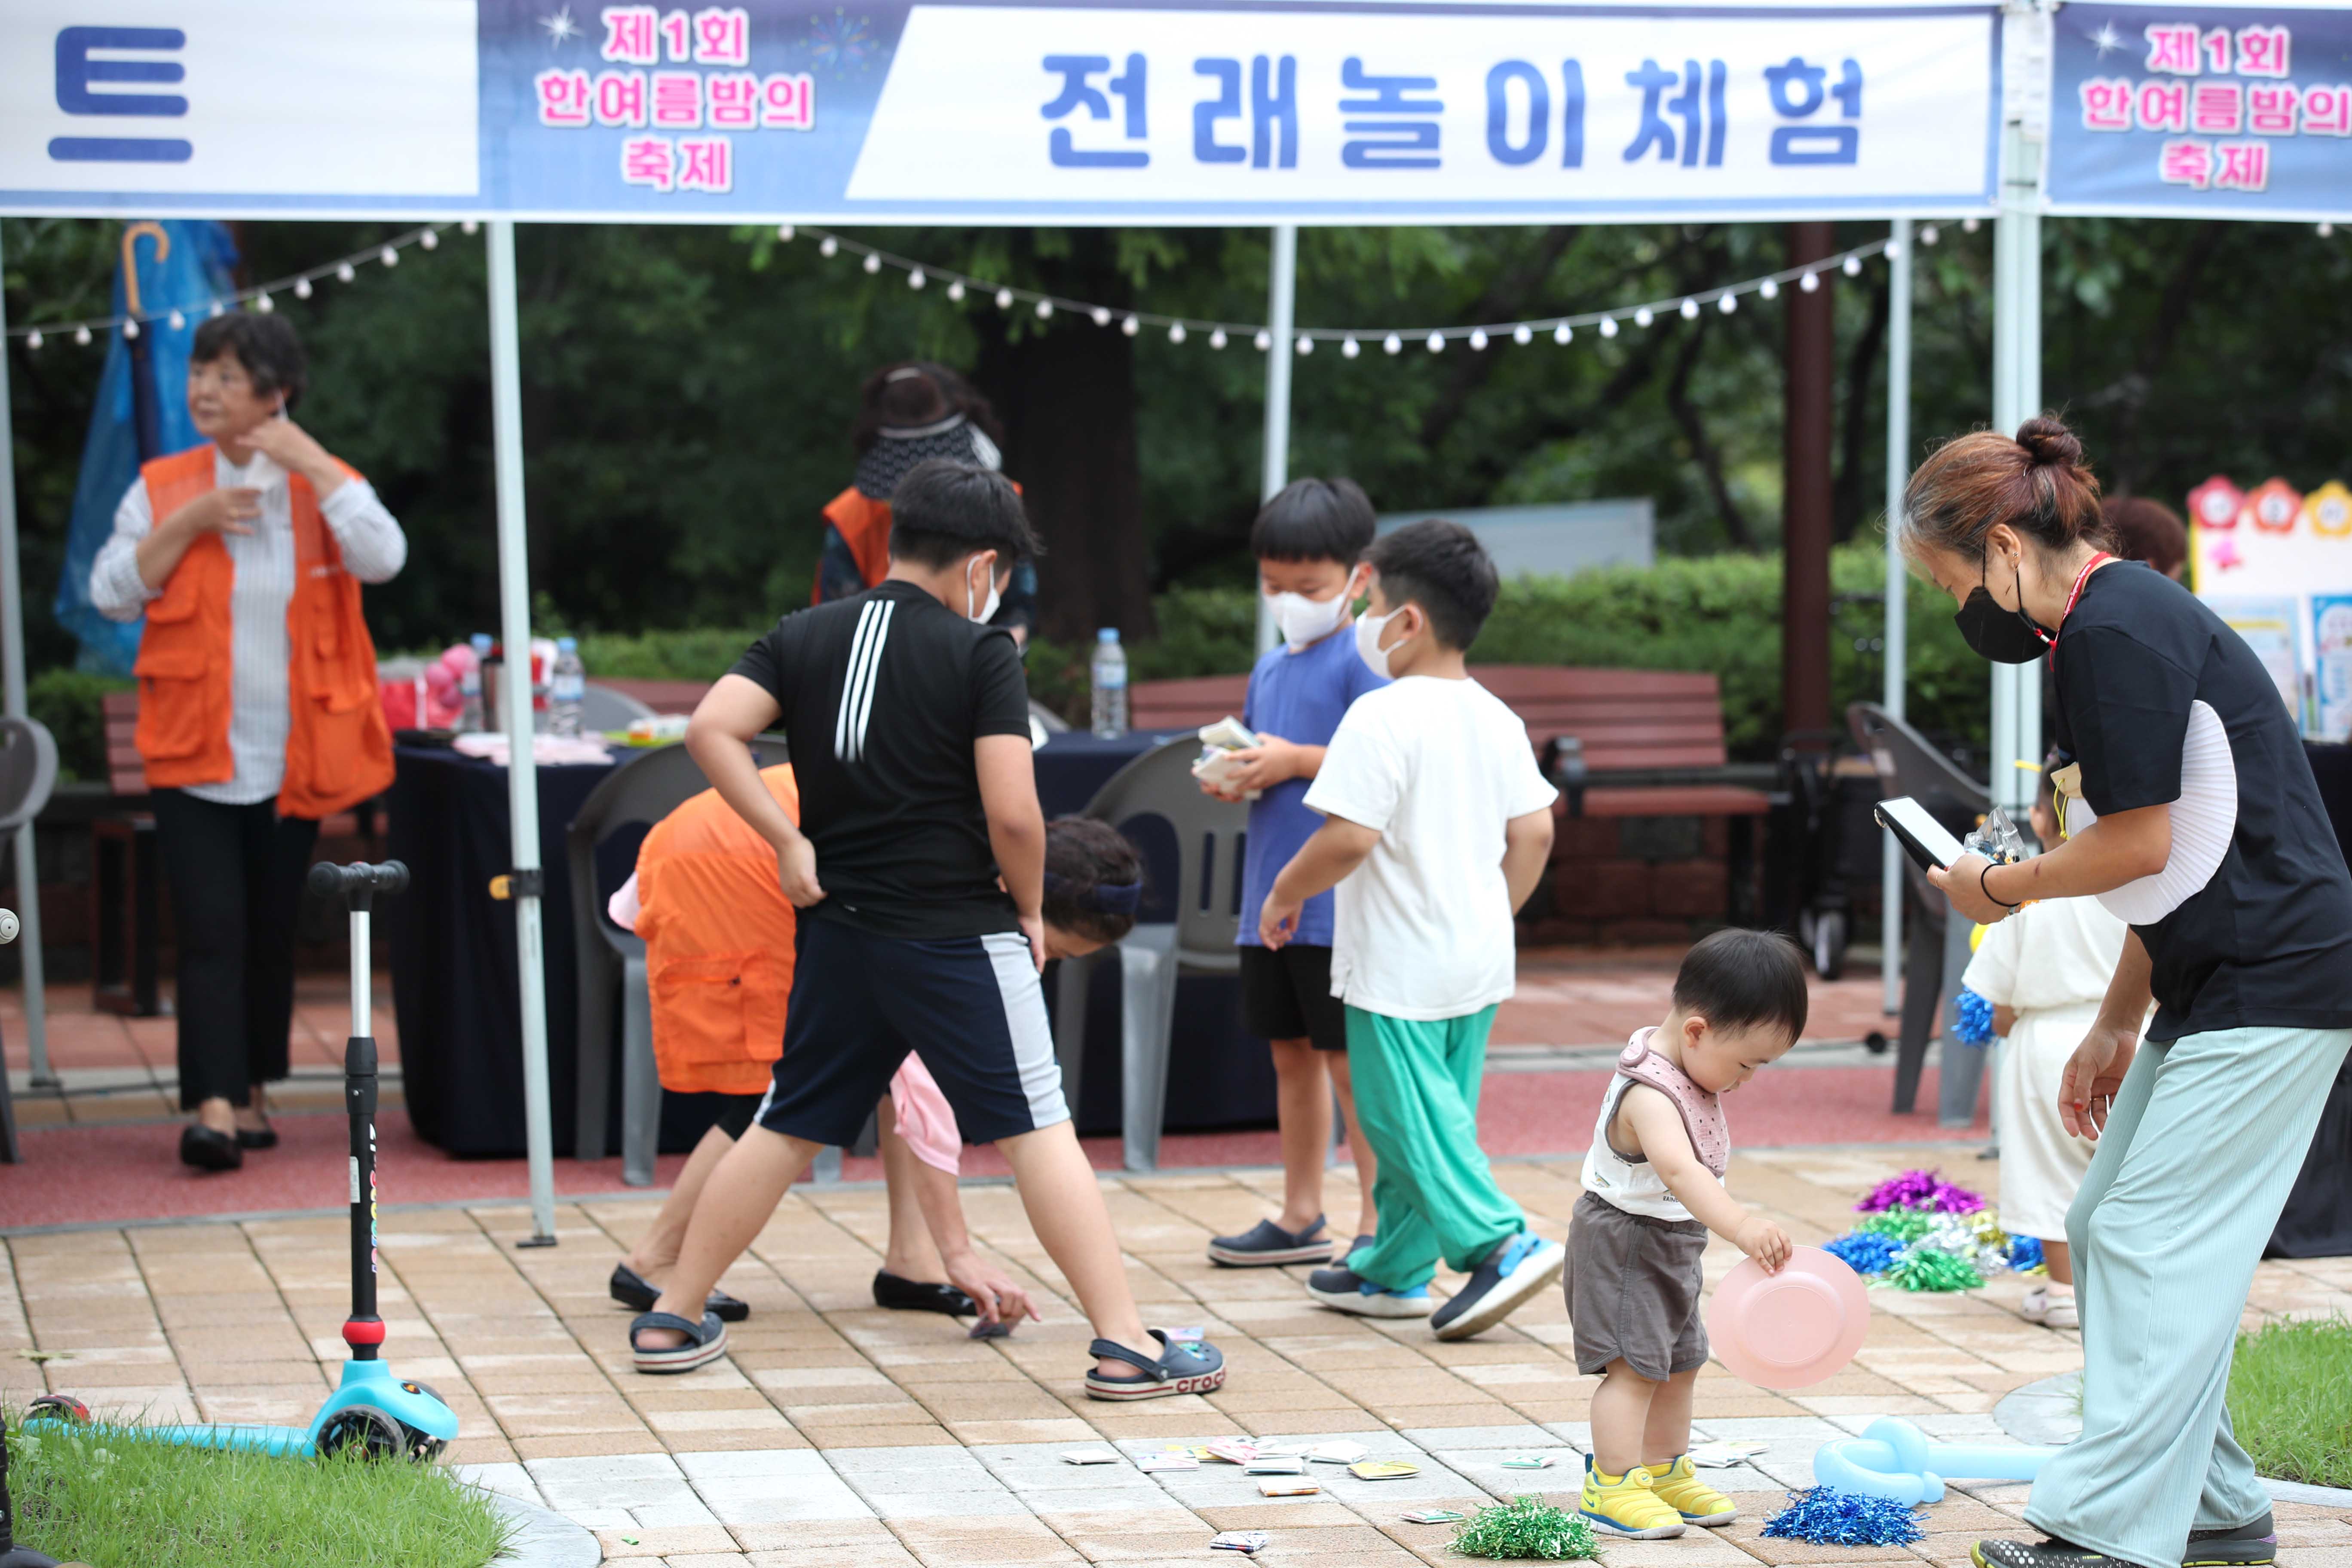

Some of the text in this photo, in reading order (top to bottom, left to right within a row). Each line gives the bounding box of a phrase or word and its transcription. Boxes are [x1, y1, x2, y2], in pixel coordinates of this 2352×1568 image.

[607, 12, 744, 61] 제1회
[2150, 29, 2286, 74] 제1회
[46, 25, 194, 163] 트
[540, 74, 810, 126] 한여름밤의
[1039, 52, 1865, 170] 전래놀이체험
[2084, 83, 2351, 133] 한여름밤의
[626, 139, 728, 187] 축제
[2164, 142, 2266, 187] 축제
